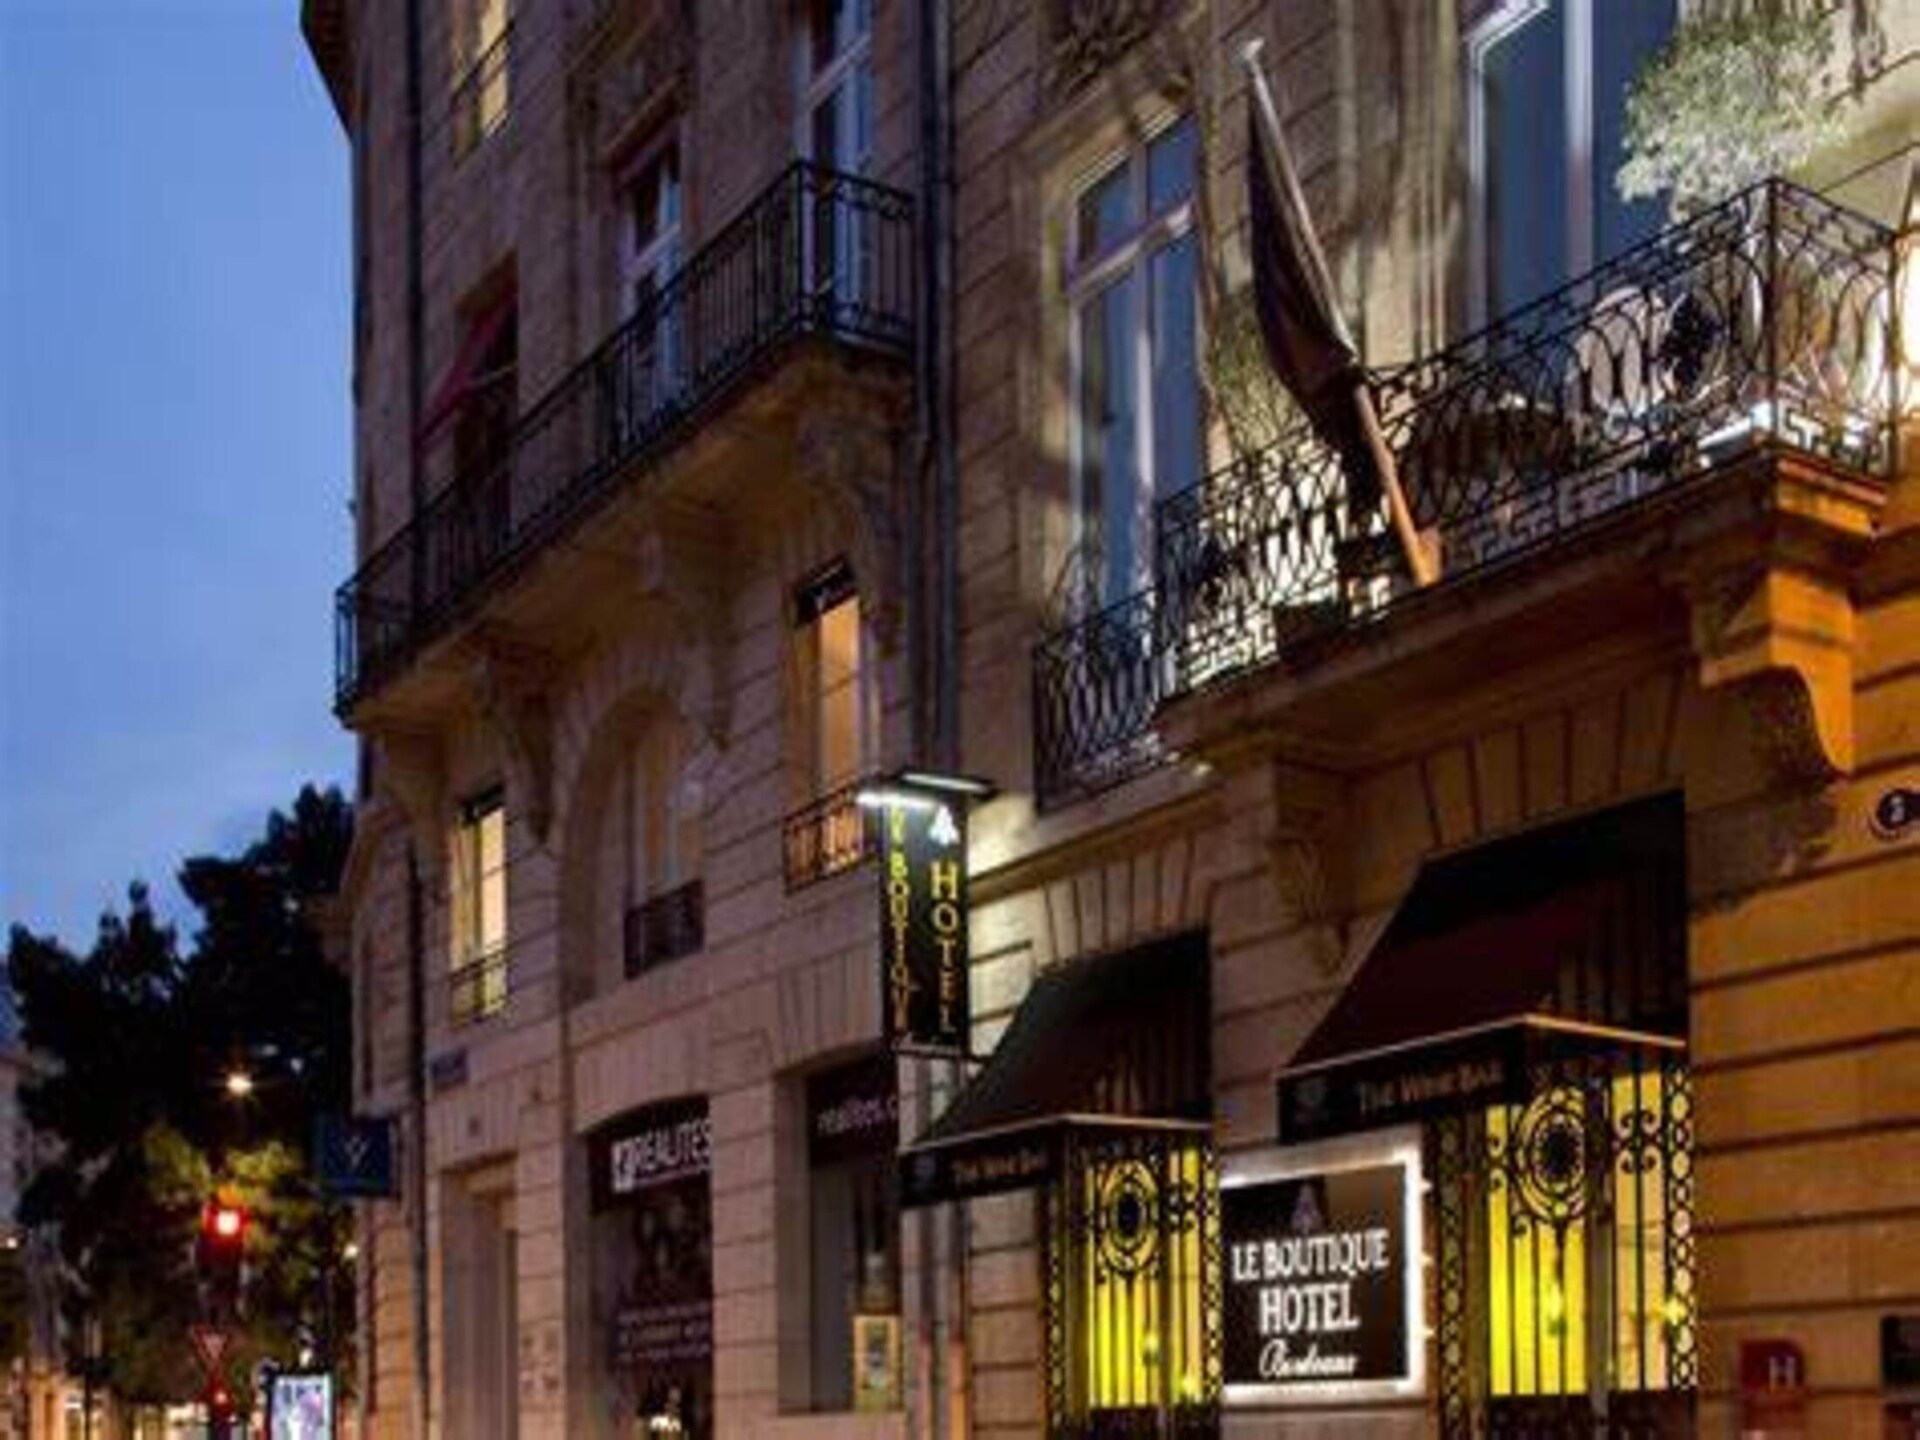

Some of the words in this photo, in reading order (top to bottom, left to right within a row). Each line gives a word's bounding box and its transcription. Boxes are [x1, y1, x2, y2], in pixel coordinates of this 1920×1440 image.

[928, 860, 959, 1033] HOTEL
[1232, 1244, 1260, 1281] LE
[1262, 1228, 1390, 1280] BOUTIQUE
[1258, 1282, 1361, 1335] HOTEL
[1767, 1355, 1797, 1392] H
